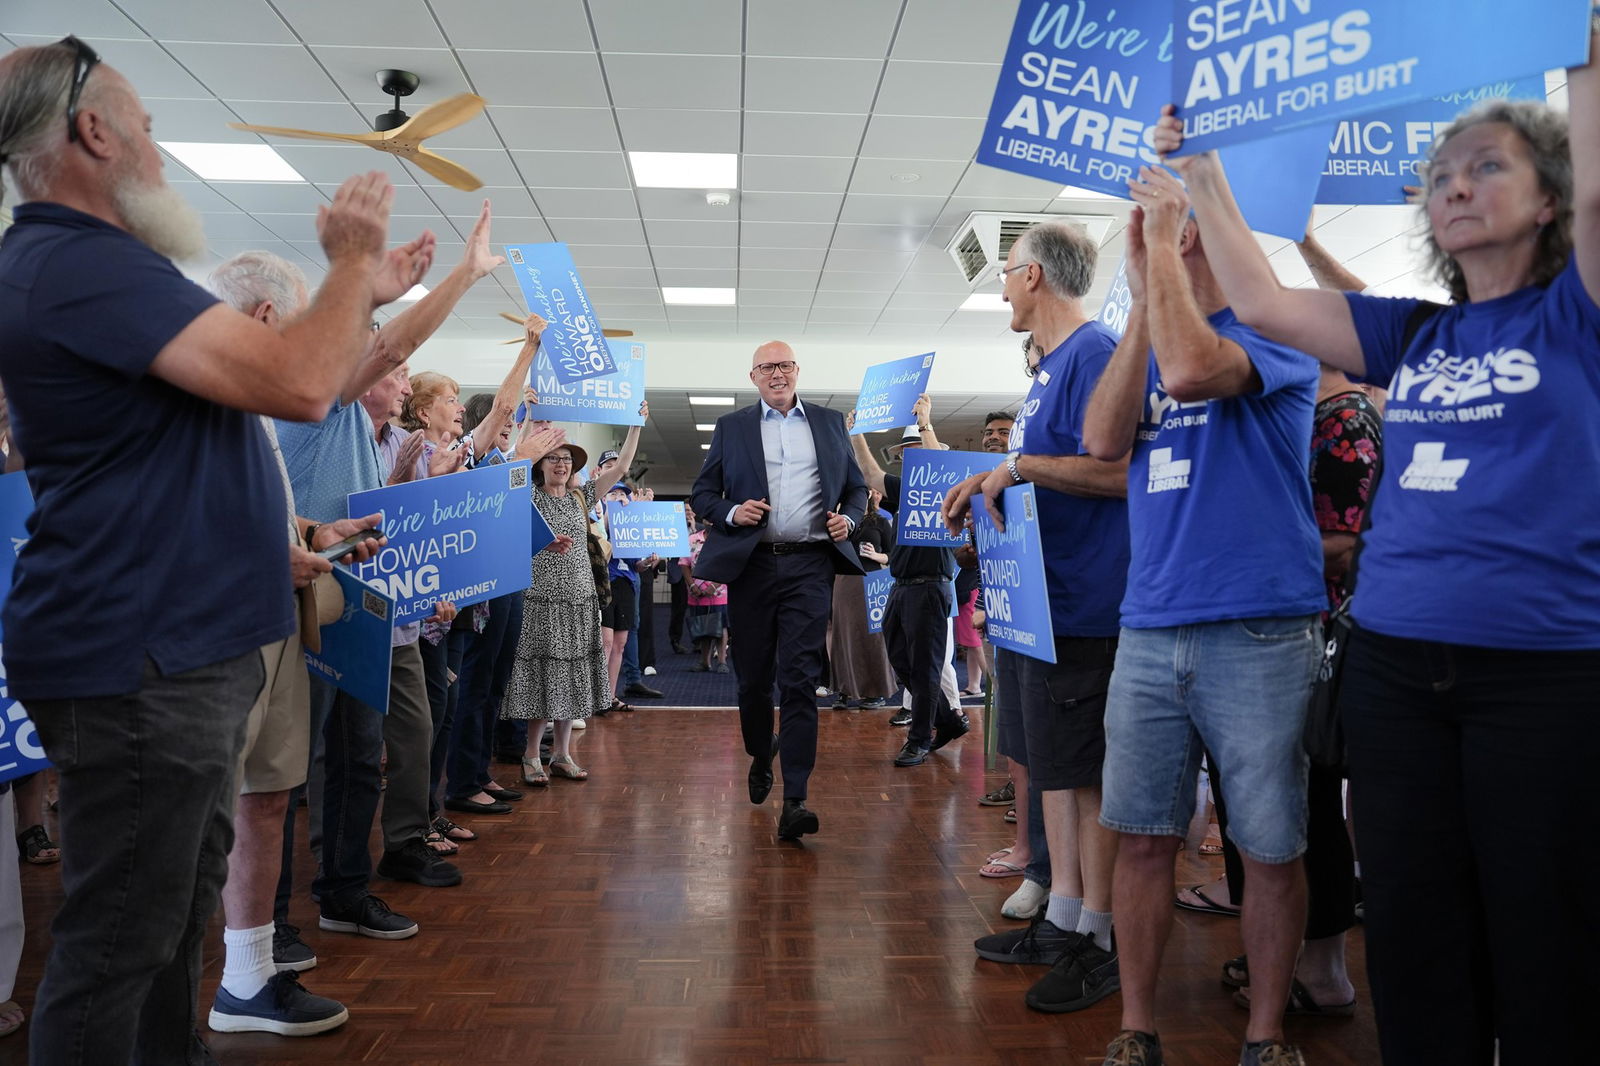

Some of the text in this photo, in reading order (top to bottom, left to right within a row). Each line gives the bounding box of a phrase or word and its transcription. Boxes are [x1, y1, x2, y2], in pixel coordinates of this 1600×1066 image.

[1027, 0, 1149, 57] We're
[1184, 10, 1372, 109] AYRES
[1017, 52, 1139, 109] SEAN
[1183, 98, 1272, 139] LIBERAL
[1276, 81, 1329, 116] FOR
[1334, 57, 1418, 100] BURT
[996, 136, 1081, 174] LIBERAL
[1085, 159, 1133, 184] FOR
[568, 270, 591, 315] TANGNEY
[552, 288, 593, 376] HOWARD
[574, 314, 605, 372] ONG
[582, 379, 632, 399] FELS
[537, 395, 626, 411] LIBERAL FOR SWAN
[855, 404, 893, 421] MOODY
[1457, 402, 1506, 422] BURT
[909, 462, 960, 488] We're
[1147, 475, 1191, 494] LIBERAL
[433, 490, 509, 527] backing
[907, 490, 944, 508] SEA
[612, 511, 640, 526] We're
[614, 528, 679, 540] MIC FELS
[904, 531, 942, 541] LIBERAL
[979, 559, 1021, 588] HOWARD
[440, 578, 498, 603] TANGNEY
[984, 587, 1013, 623] ONG
